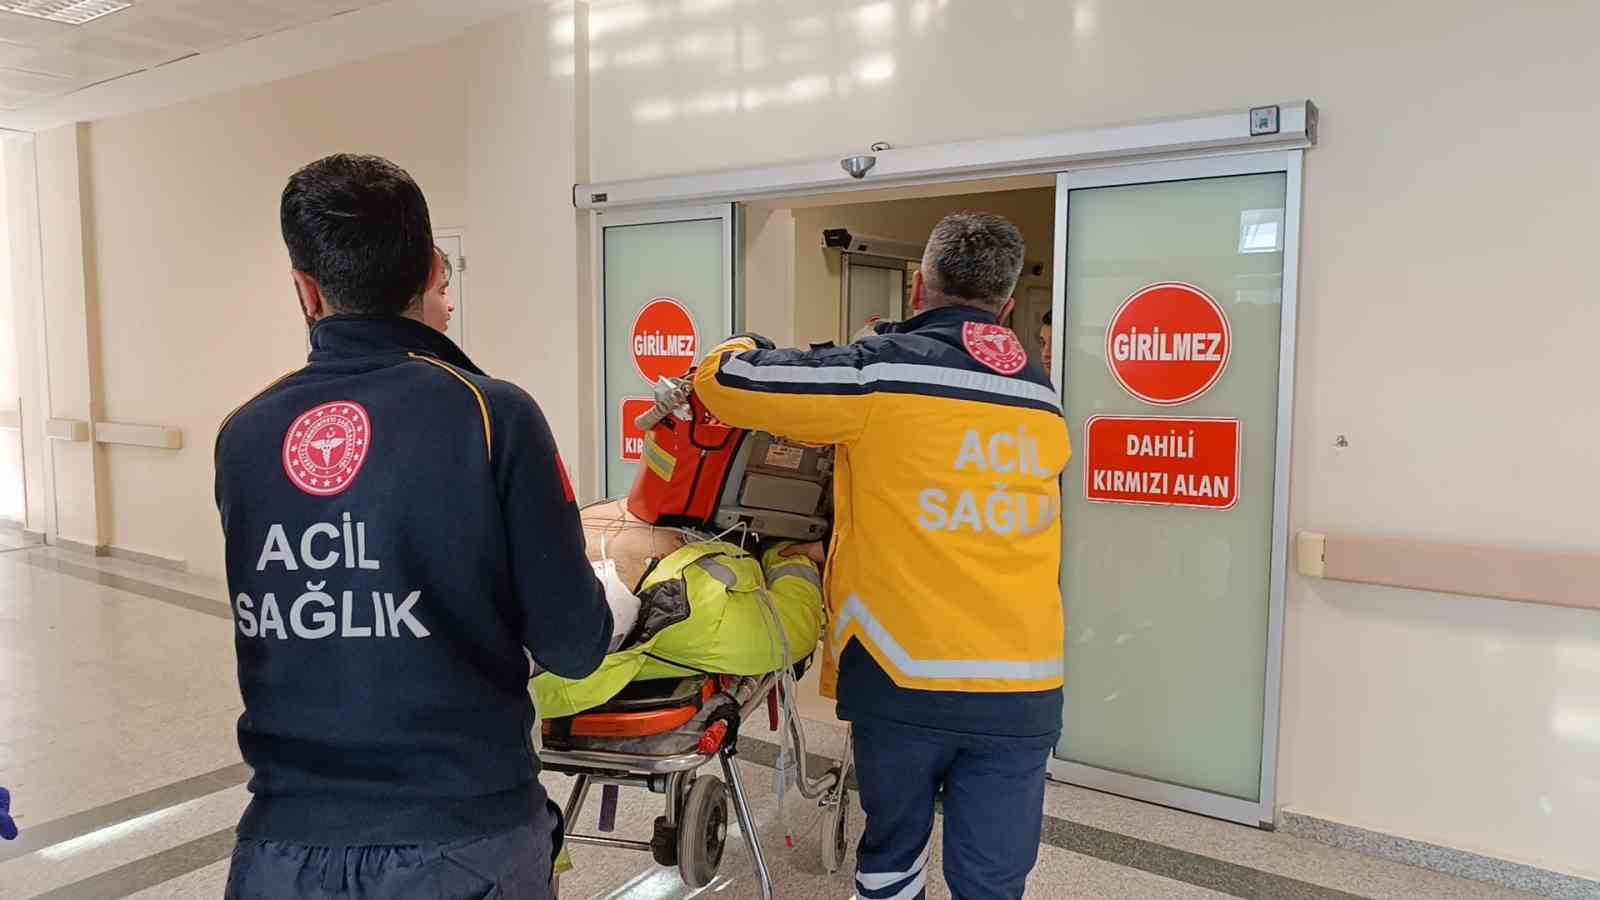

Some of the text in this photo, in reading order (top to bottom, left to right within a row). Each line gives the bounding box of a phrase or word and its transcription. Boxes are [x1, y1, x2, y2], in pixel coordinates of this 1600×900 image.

[634, 330, 694, 357] GİRİLMEZ
[1114, 326, 1222, 361] GİRİLMEZ
[953, 424, 1050, 479] ACİL
[1126, 430, 1195, 458] DAHİLİ
[1093, 469, 1229, 498] KIRMIZI ALAN
[918, 482, 1057, 536] SAĞLI
[256, 511, 381, 571] ACİL
[236, 580, 431, 639] SAĞLIK
